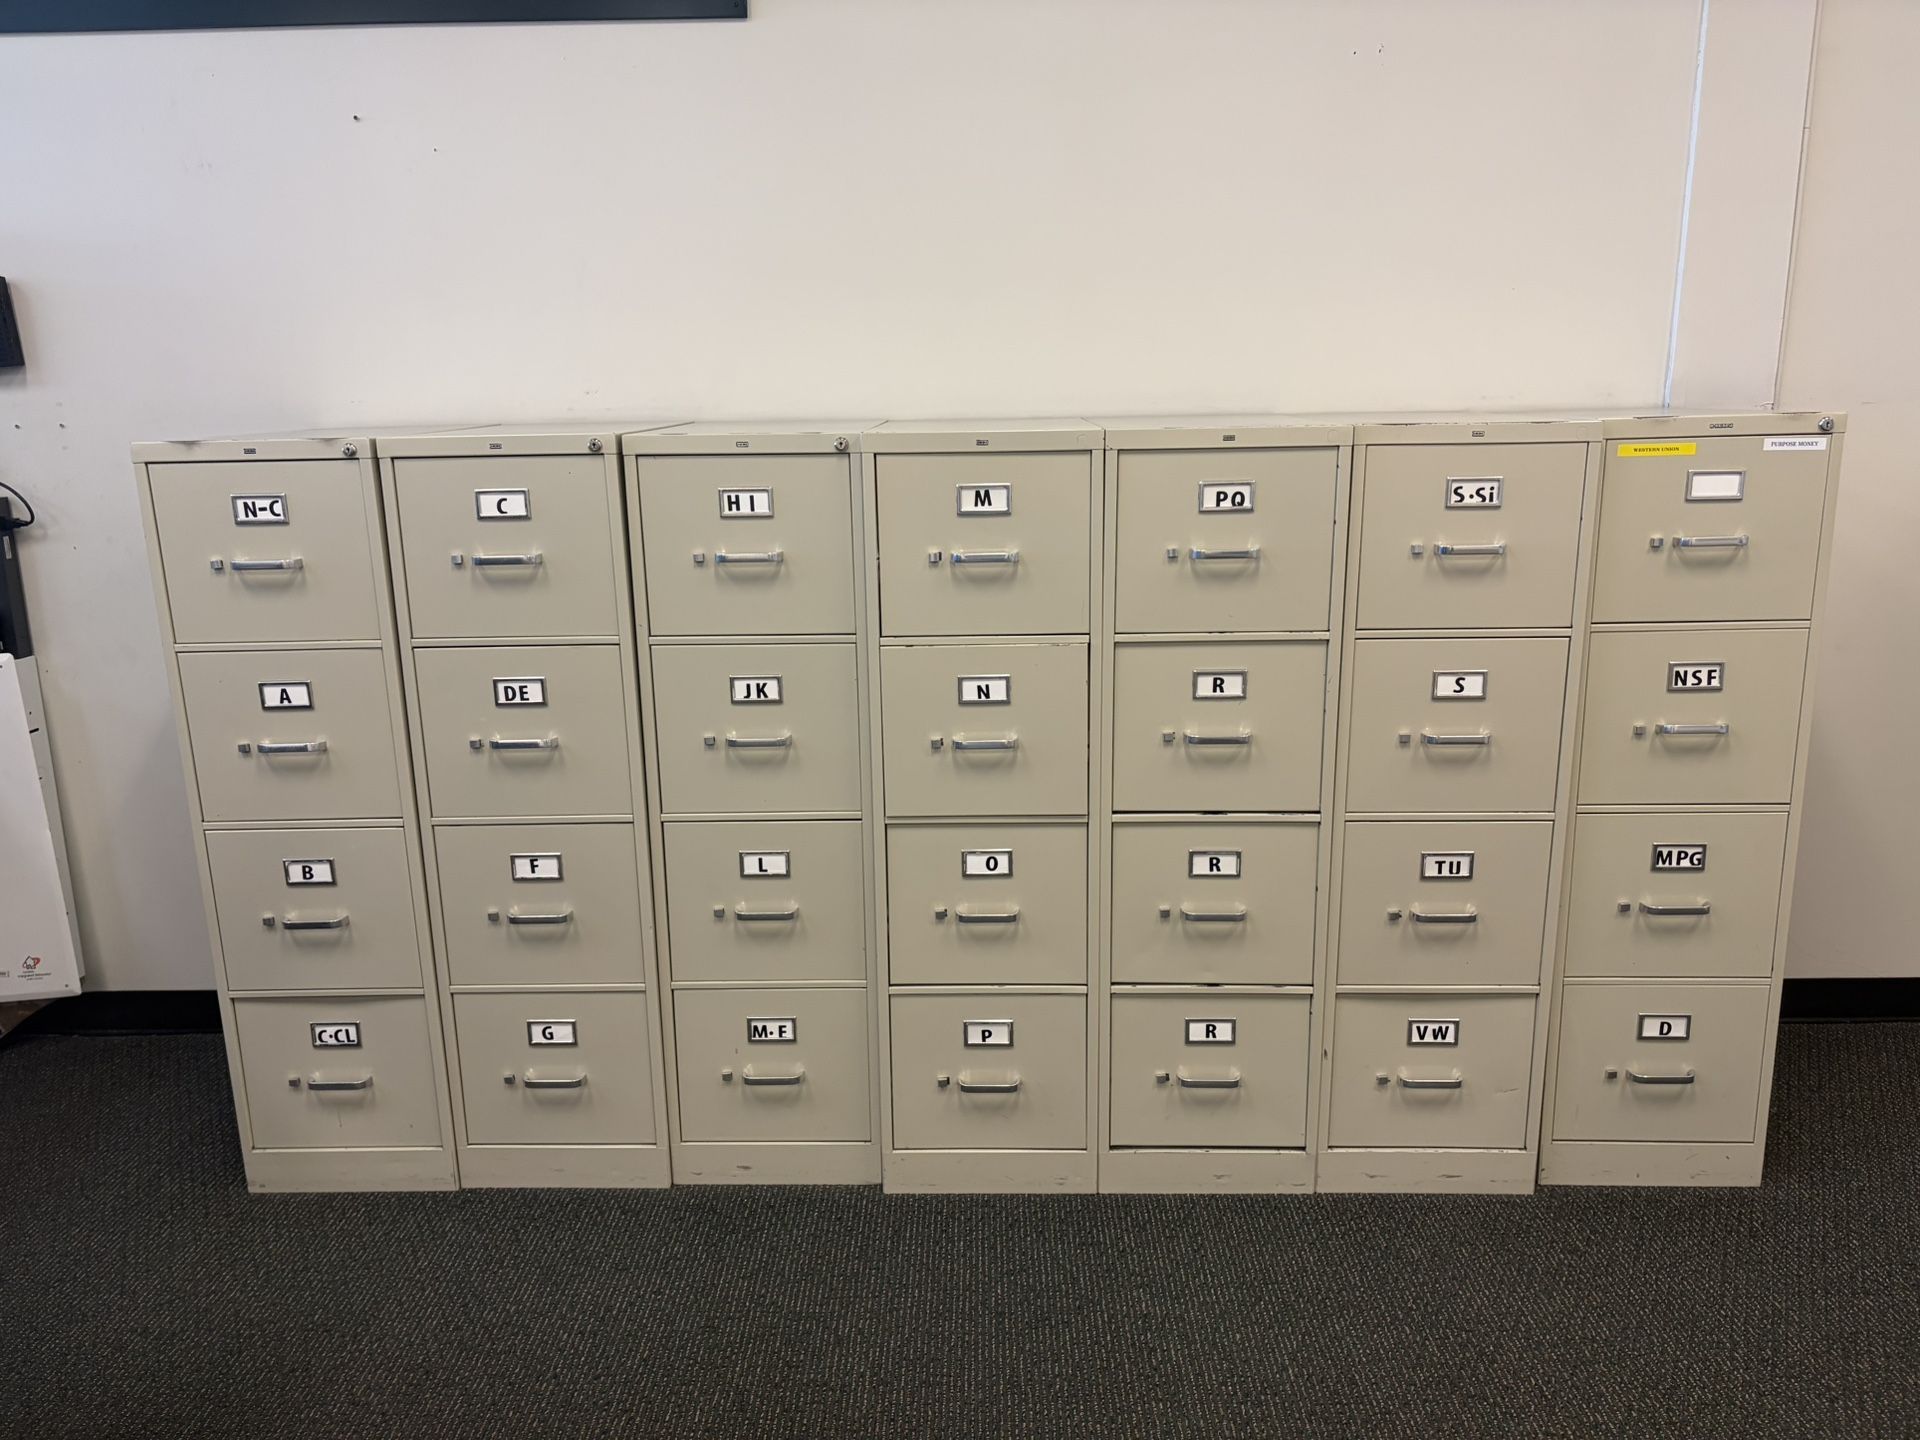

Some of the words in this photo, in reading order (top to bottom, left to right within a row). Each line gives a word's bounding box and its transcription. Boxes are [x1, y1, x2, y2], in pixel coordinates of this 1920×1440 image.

[497, 498, 508, 514] C
[974, 489, 992, 507] M
[1215, 491, 1246, 508] PQ
[1212, 677, 1225, 693] R
[1453, 677, 1466, 693] S
[1674, 669, 1718, 687] NSF
[279, 688, 292, 704] A
[503, 685, 530, 702] DE
[743, 682, 769, 699] JK
[977, 684, 990, 699] N
[529, 858, 539, 874] F
[758, 857, 768, 873] L
[985, 856, 999, 871] O
[1209, 858, 1221, 872] R
[1656, 850, 1702, 866] MPG
[301, 864, 314, 881] B
[1434, 860, 1462, 875] TU
[541, 1025, 554, 1041] G
[981, 1029, 993, 1043] P
[1205, 1023, 1217, 1039] R
[1415, 1025, 1450, 1041] VW
[1658, 1021, 1672, 1036] D
